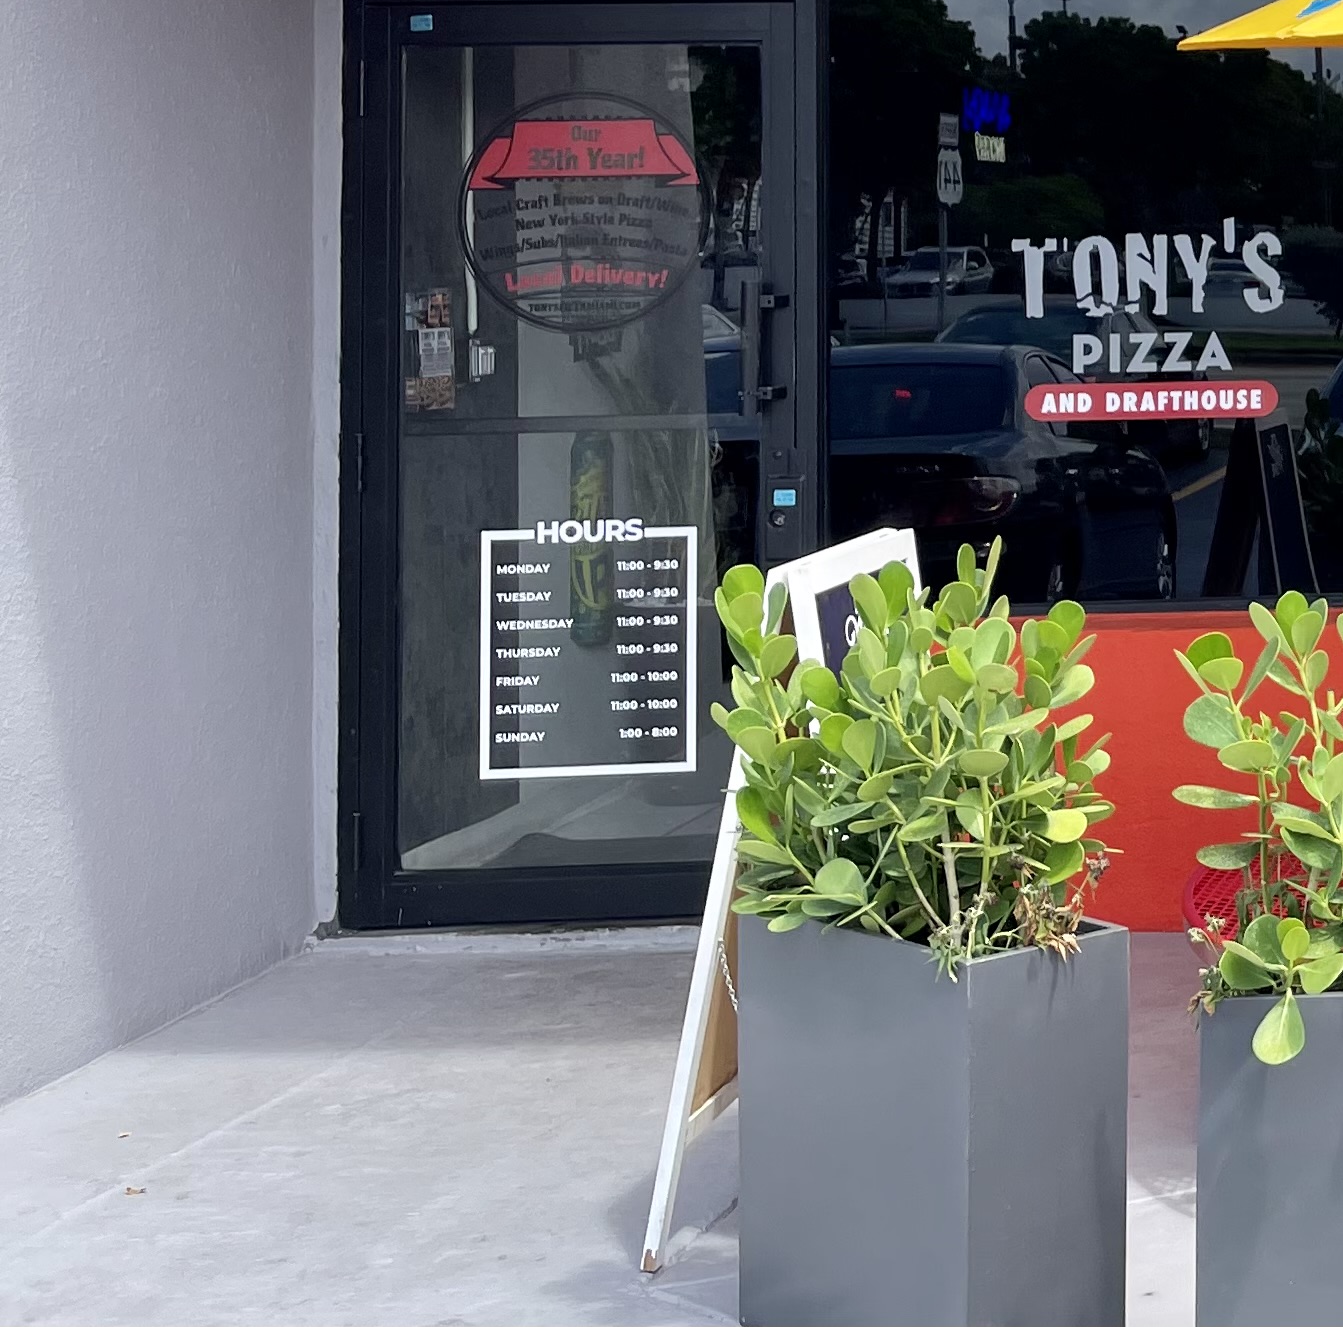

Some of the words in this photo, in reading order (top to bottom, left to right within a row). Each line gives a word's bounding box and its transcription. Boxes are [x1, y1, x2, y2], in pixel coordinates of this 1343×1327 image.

[571, 125, 601, 142] Our
[528, 147, 578, 170] 35th
[587, 145, 645, 170] Year!
[516, 194, 548, 211] Craft
[515, 216, 545, 231] New
[571, 263, 669, 290] Delivery!
[1012, 217, 1285, 319] TONY'S
[1073, 331, 1233, 374] PIZZA
[1041, 393, 1093, 414] AND
[1105, 389, 1262, 414] DRAFTHOUSE
[536, 519, 645, 544] HOURS
[496, 563, 551, 575] MONDAY
[617, 560, 644, 572] 11:00
[653, 559, 679, 571] 9:30
[496, 591, 552, 603] TUESDAY
[617, 588, 644, 600] 11:00
[653, 587, 679, 598] 9:30
[496, 618, 574, 631] WEDNESDAY
[617, 616, 644, 627] 11:00
[653, 615, 678, 626] 9:30
[496, 647, 561, 659] THURSDAY
[616, 644, 643, 655] 11:00
[653, 643, 678, 654] 9:30
[496, 675, 540, 687] FRIDAY
[611, 672, 638, 683] 11:00
[647, 670, 678, 682] 10:00
[495, 703, 560, 715] SATURDAY
[611, 700, 638, 711] 11:00
[647, 698, 678, 710] 10:00
[495, 731, 546, 743] SUNDAY
[619, 728, 643, 739] 1:00
[652, 727, 678, 738] 8:00
